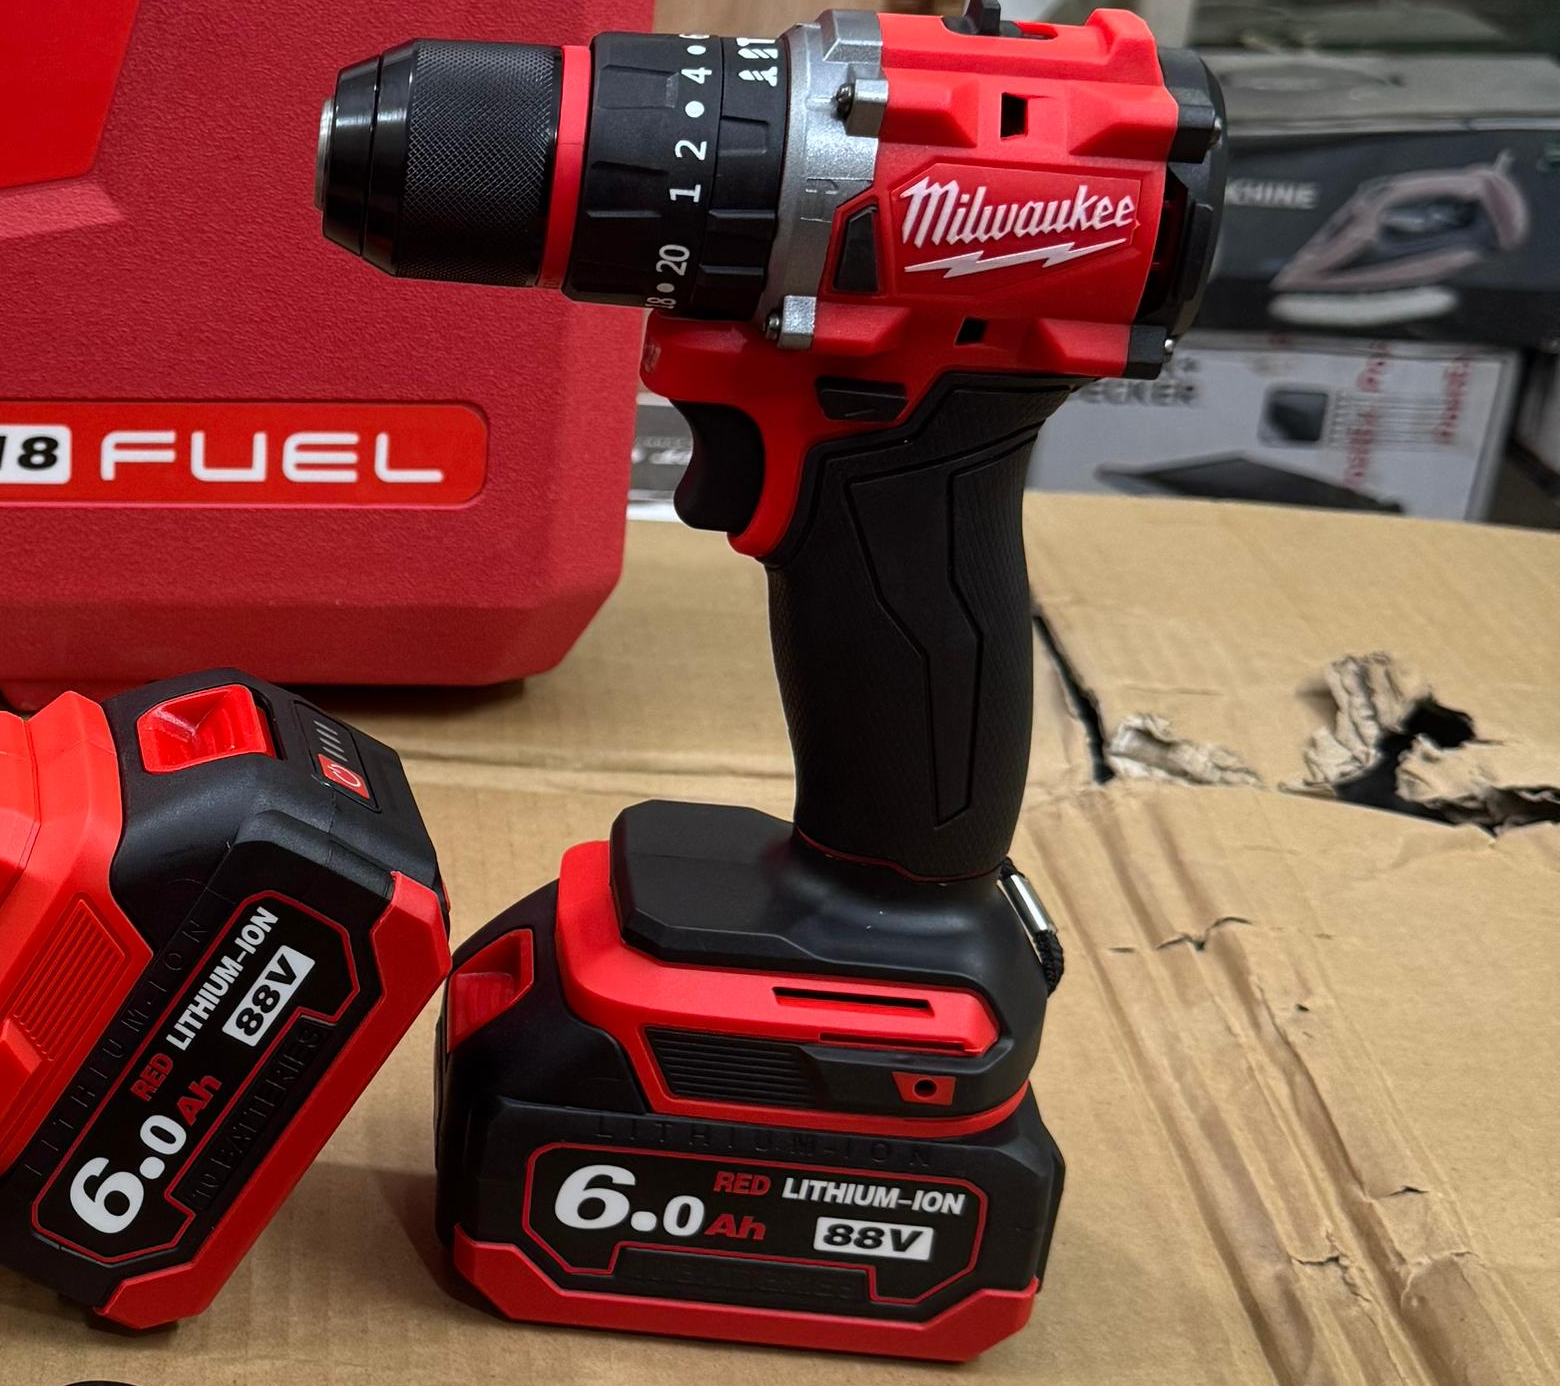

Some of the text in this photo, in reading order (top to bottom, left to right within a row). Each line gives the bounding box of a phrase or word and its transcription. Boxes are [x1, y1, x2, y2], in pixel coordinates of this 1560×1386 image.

[680, 66, 713, 85] 4
[674, 139, 708, 161] 2
[669, 183, 702, 204] 1
[899, 174, 1137, 249] Milwaukee
[656, 243, 691, 277] 20
[99, 429, 445, 483] FUEL
[130, 905, 281, 1101] RED LITHIUM-ION
[233, 951, 302, 1038] 88V
[713, 1169, 966, 1216] RED LITHIUM-ION
[823, 1222, 930, 1254] 88V
